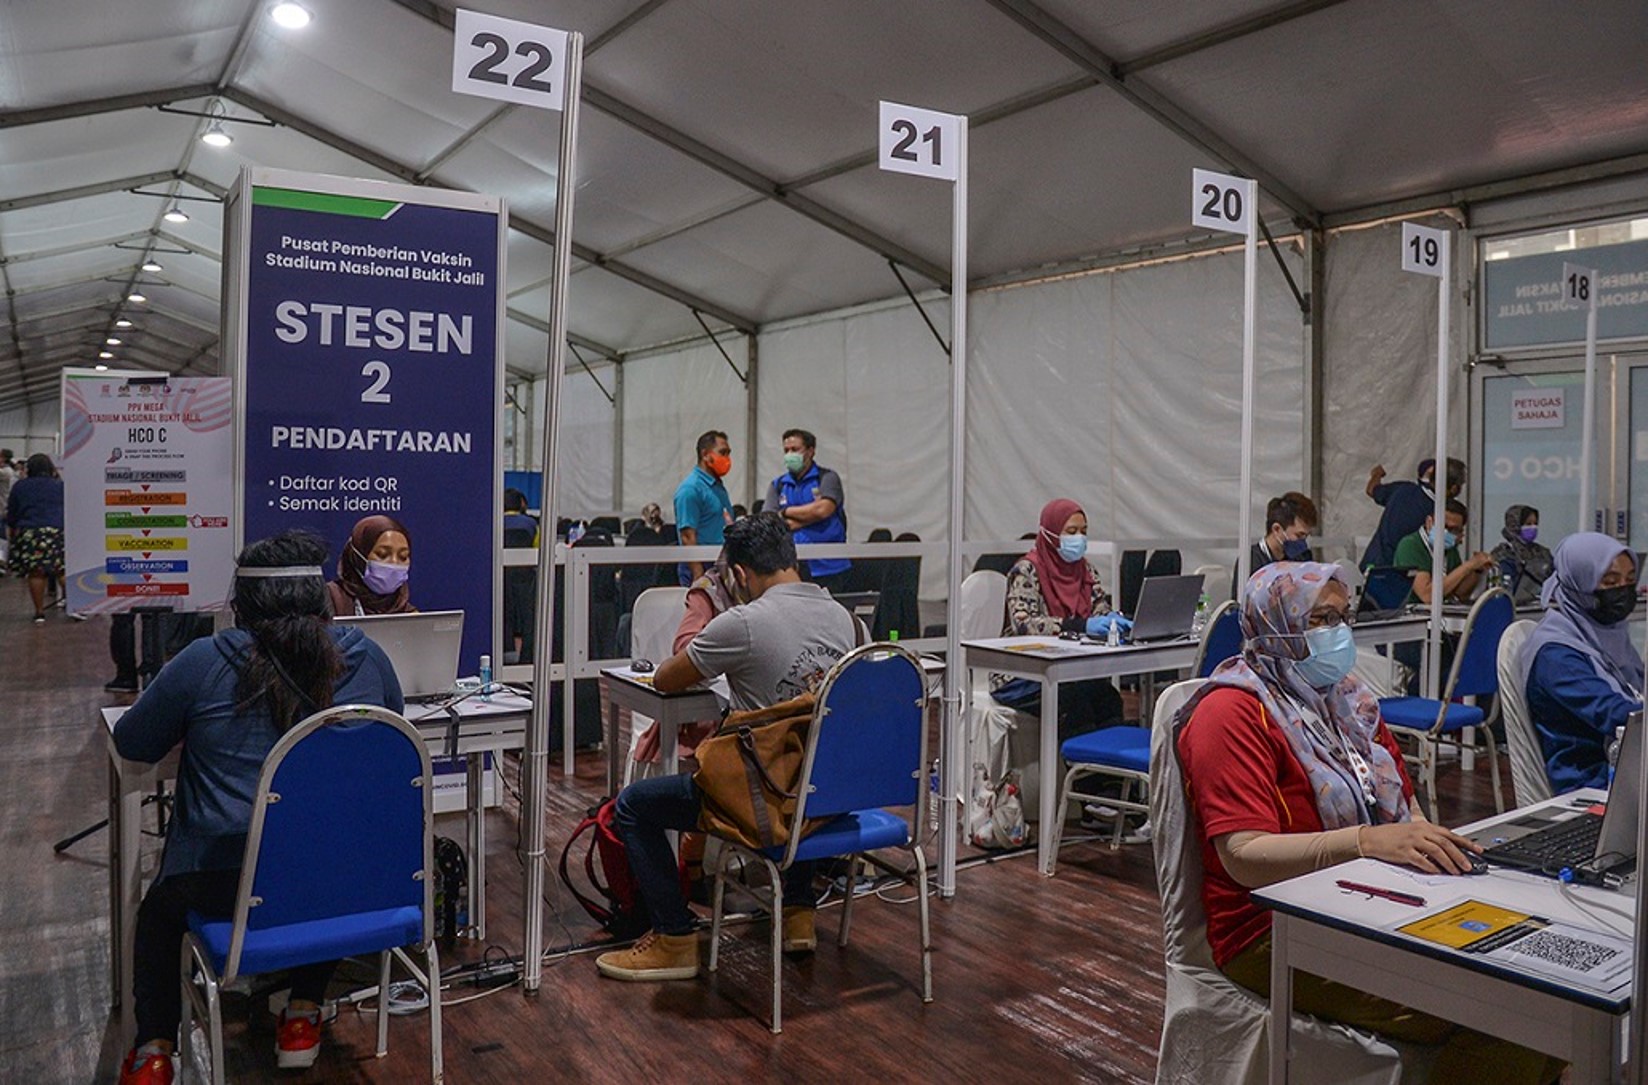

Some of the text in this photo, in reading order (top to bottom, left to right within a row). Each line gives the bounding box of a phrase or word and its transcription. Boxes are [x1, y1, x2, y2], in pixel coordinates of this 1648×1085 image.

[468, 32, 553, 94] 22
[891, 119, 942, 166] 21
[1201, 184, 1243, 222] 20
[282, 235, 472, 267] Pusat Pemberian Vaksin
[1410, 235, 1438, 267] 19
[266, 252, 485, 286] Stadium Nasional Bukit Jalil
[1568, 273, 1589, 301] 18
[275, 300, 473, 354] STESEN
[361, 361, 391, 403] 2
[128, 402, 164, 411] PPV MEGA
[1515, 398, 1561, 407] PETUGAS
[88, 414, 119, 423] STADIUM
[122, 414, 157, 423] NASIONAL
[159, 414, 180, 422] BUKIT
[1518, 411, 1557, 419] SAHAJA
[129, 428, 167, 443] HCO C
[271, 426, 472, 453] PENDAFTARAN
[107, 471, 133, 480] TRIAGE
[140, 471, 184, 480] SCREENING
[280, 476, 398, 491] Daftar kod QR
[119, 495, 172, 503] REGISTRATION
[280, 496, 401, 511] Semak identiti
[119, 539, 174, 547] VACCINATION
[120, 561, 174, 570] OBSERVATION
[788, 646, 815, 677] SANTA
